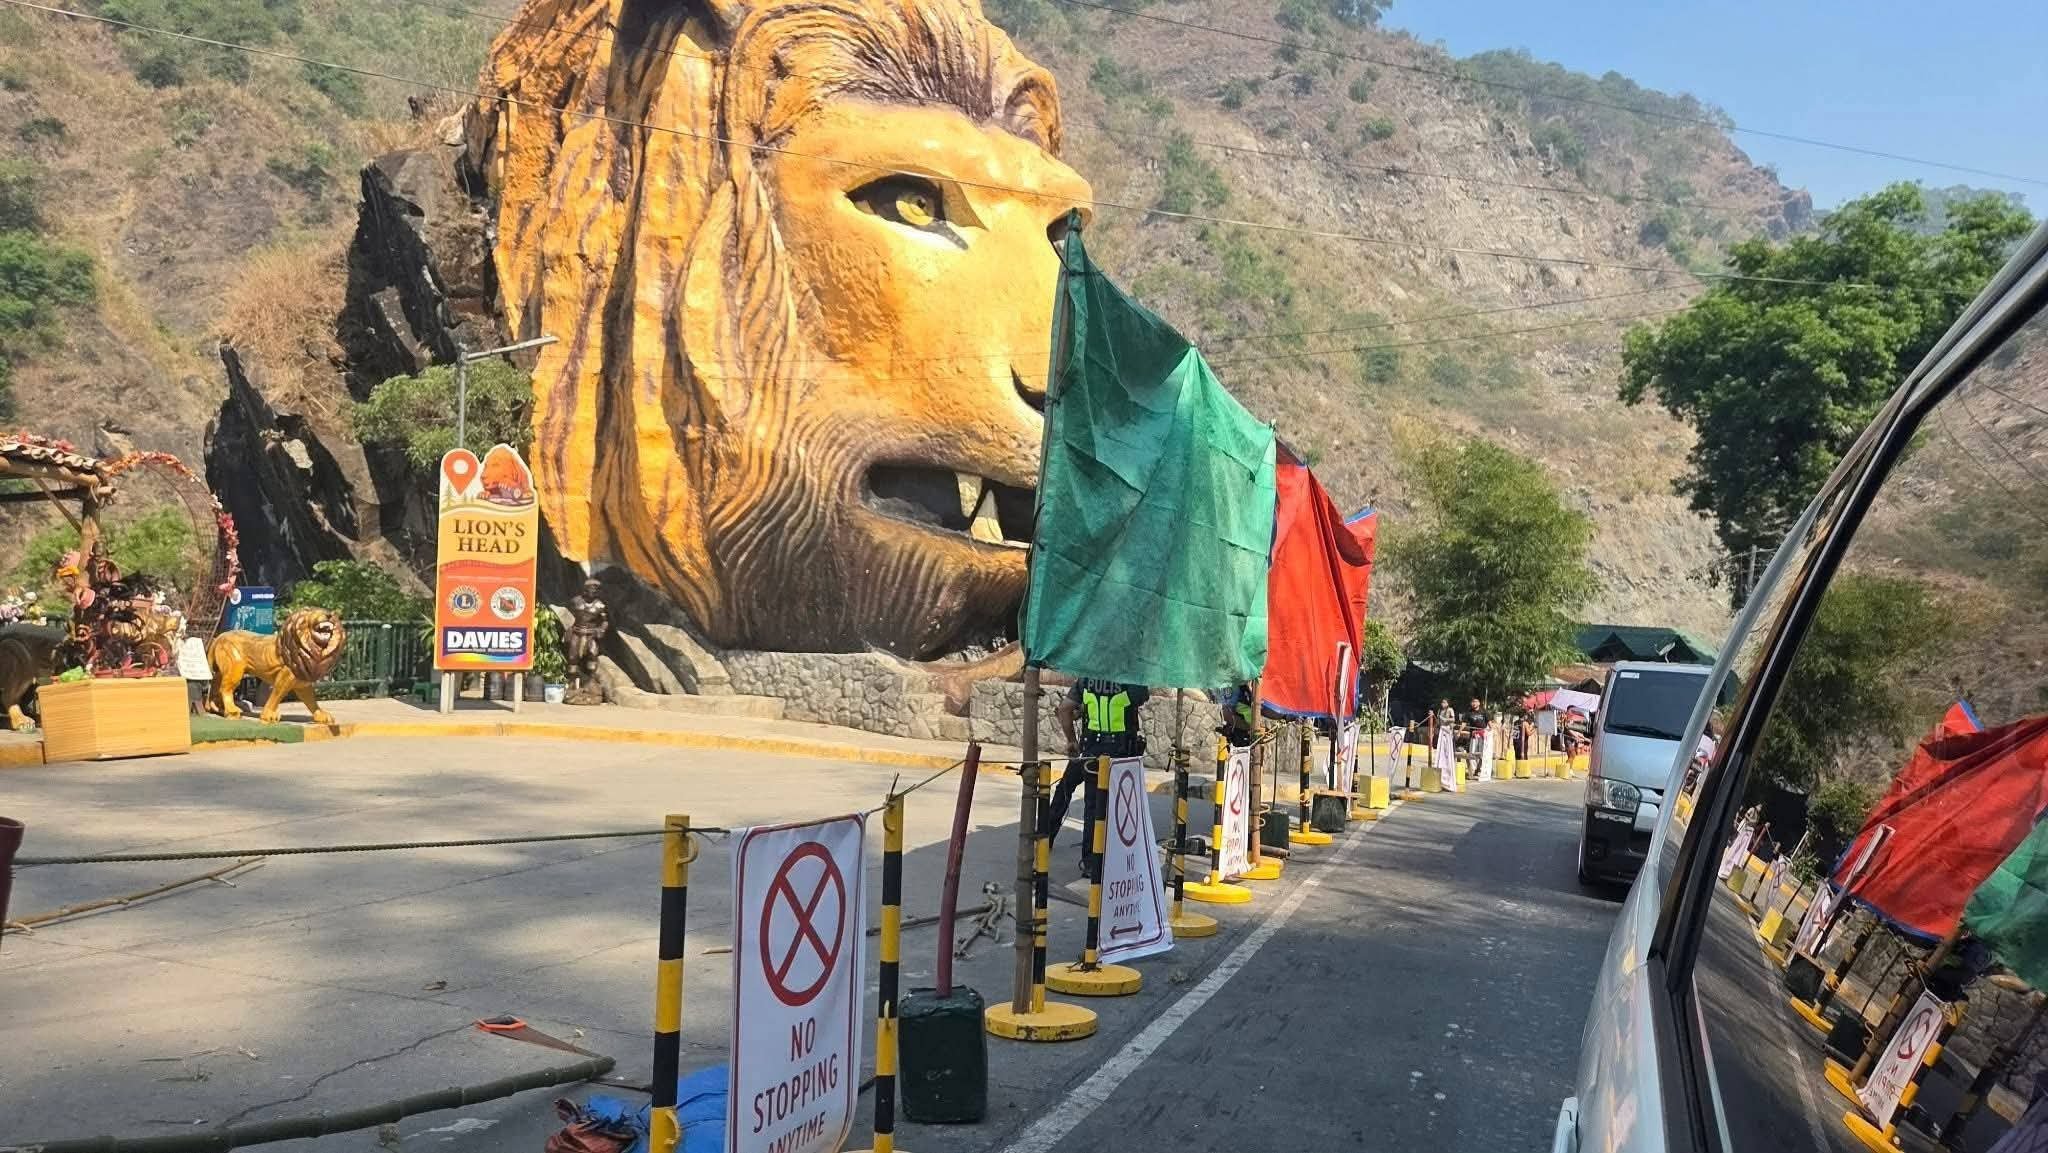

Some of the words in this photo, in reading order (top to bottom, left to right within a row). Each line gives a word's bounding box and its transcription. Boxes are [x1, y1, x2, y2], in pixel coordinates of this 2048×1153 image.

[453, 518, 526, 537] LION'S
[457, 536, 520, 554] HEAD
[447, 631, 523, 649] DAVIES
[1126, 853, 1135, 873] NO
[1108, 874, 1144, 900] STOPG
[791, 1017, 816, 1062] NO
[752, 1053, 838, 1134] STOPPING
